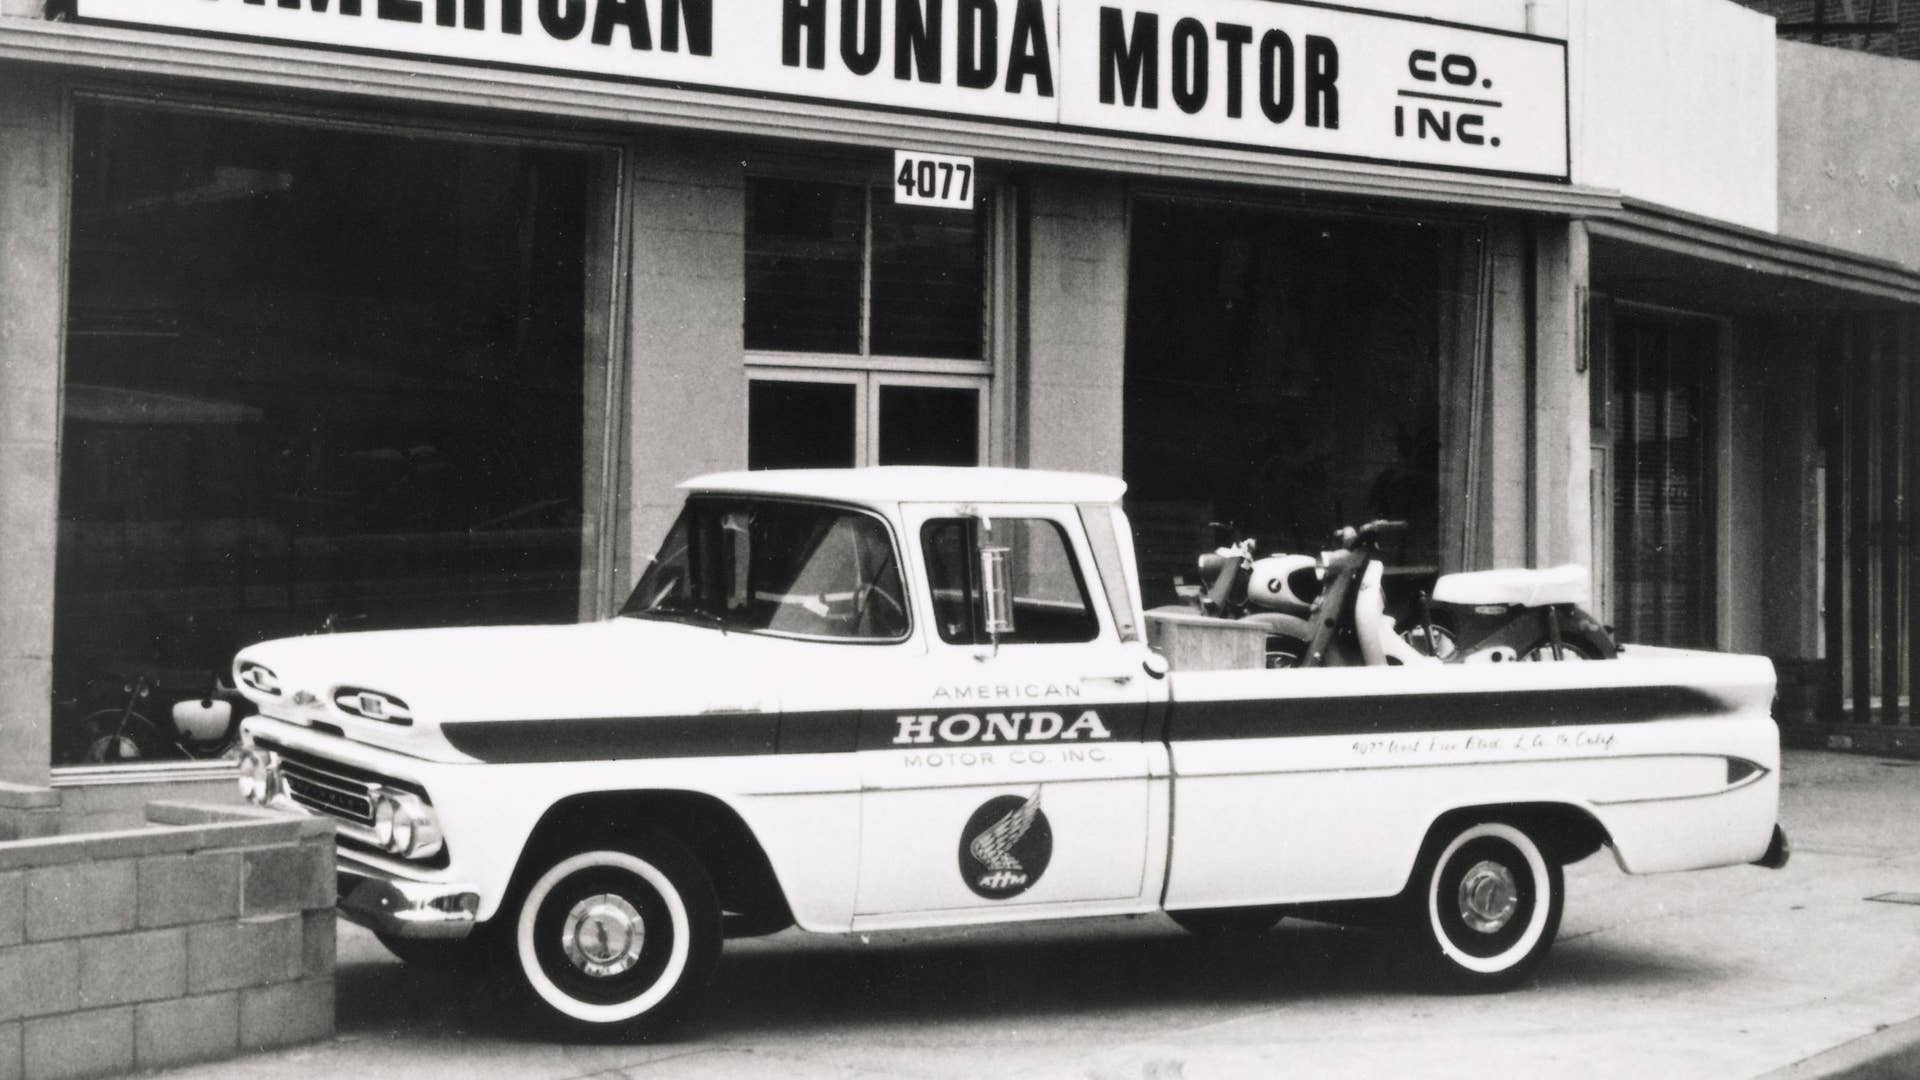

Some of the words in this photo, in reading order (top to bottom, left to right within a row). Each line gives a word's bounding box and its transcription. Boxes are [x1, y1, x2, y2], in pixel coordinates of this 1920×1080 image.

[783, 0, 1054, 98] HONDA
[1100, 6, 1339, 130] MOTOR
[1408, 49, 1492, 89] CO.
[1394, 105, 1501, 147] INC.
[897, 159, 972, 201] 4077
[932, 684, 1081, 700] AMERICAN
[893, 710, 1111, 744] HONDA
[904, 751, 994, 768] MOTOR
